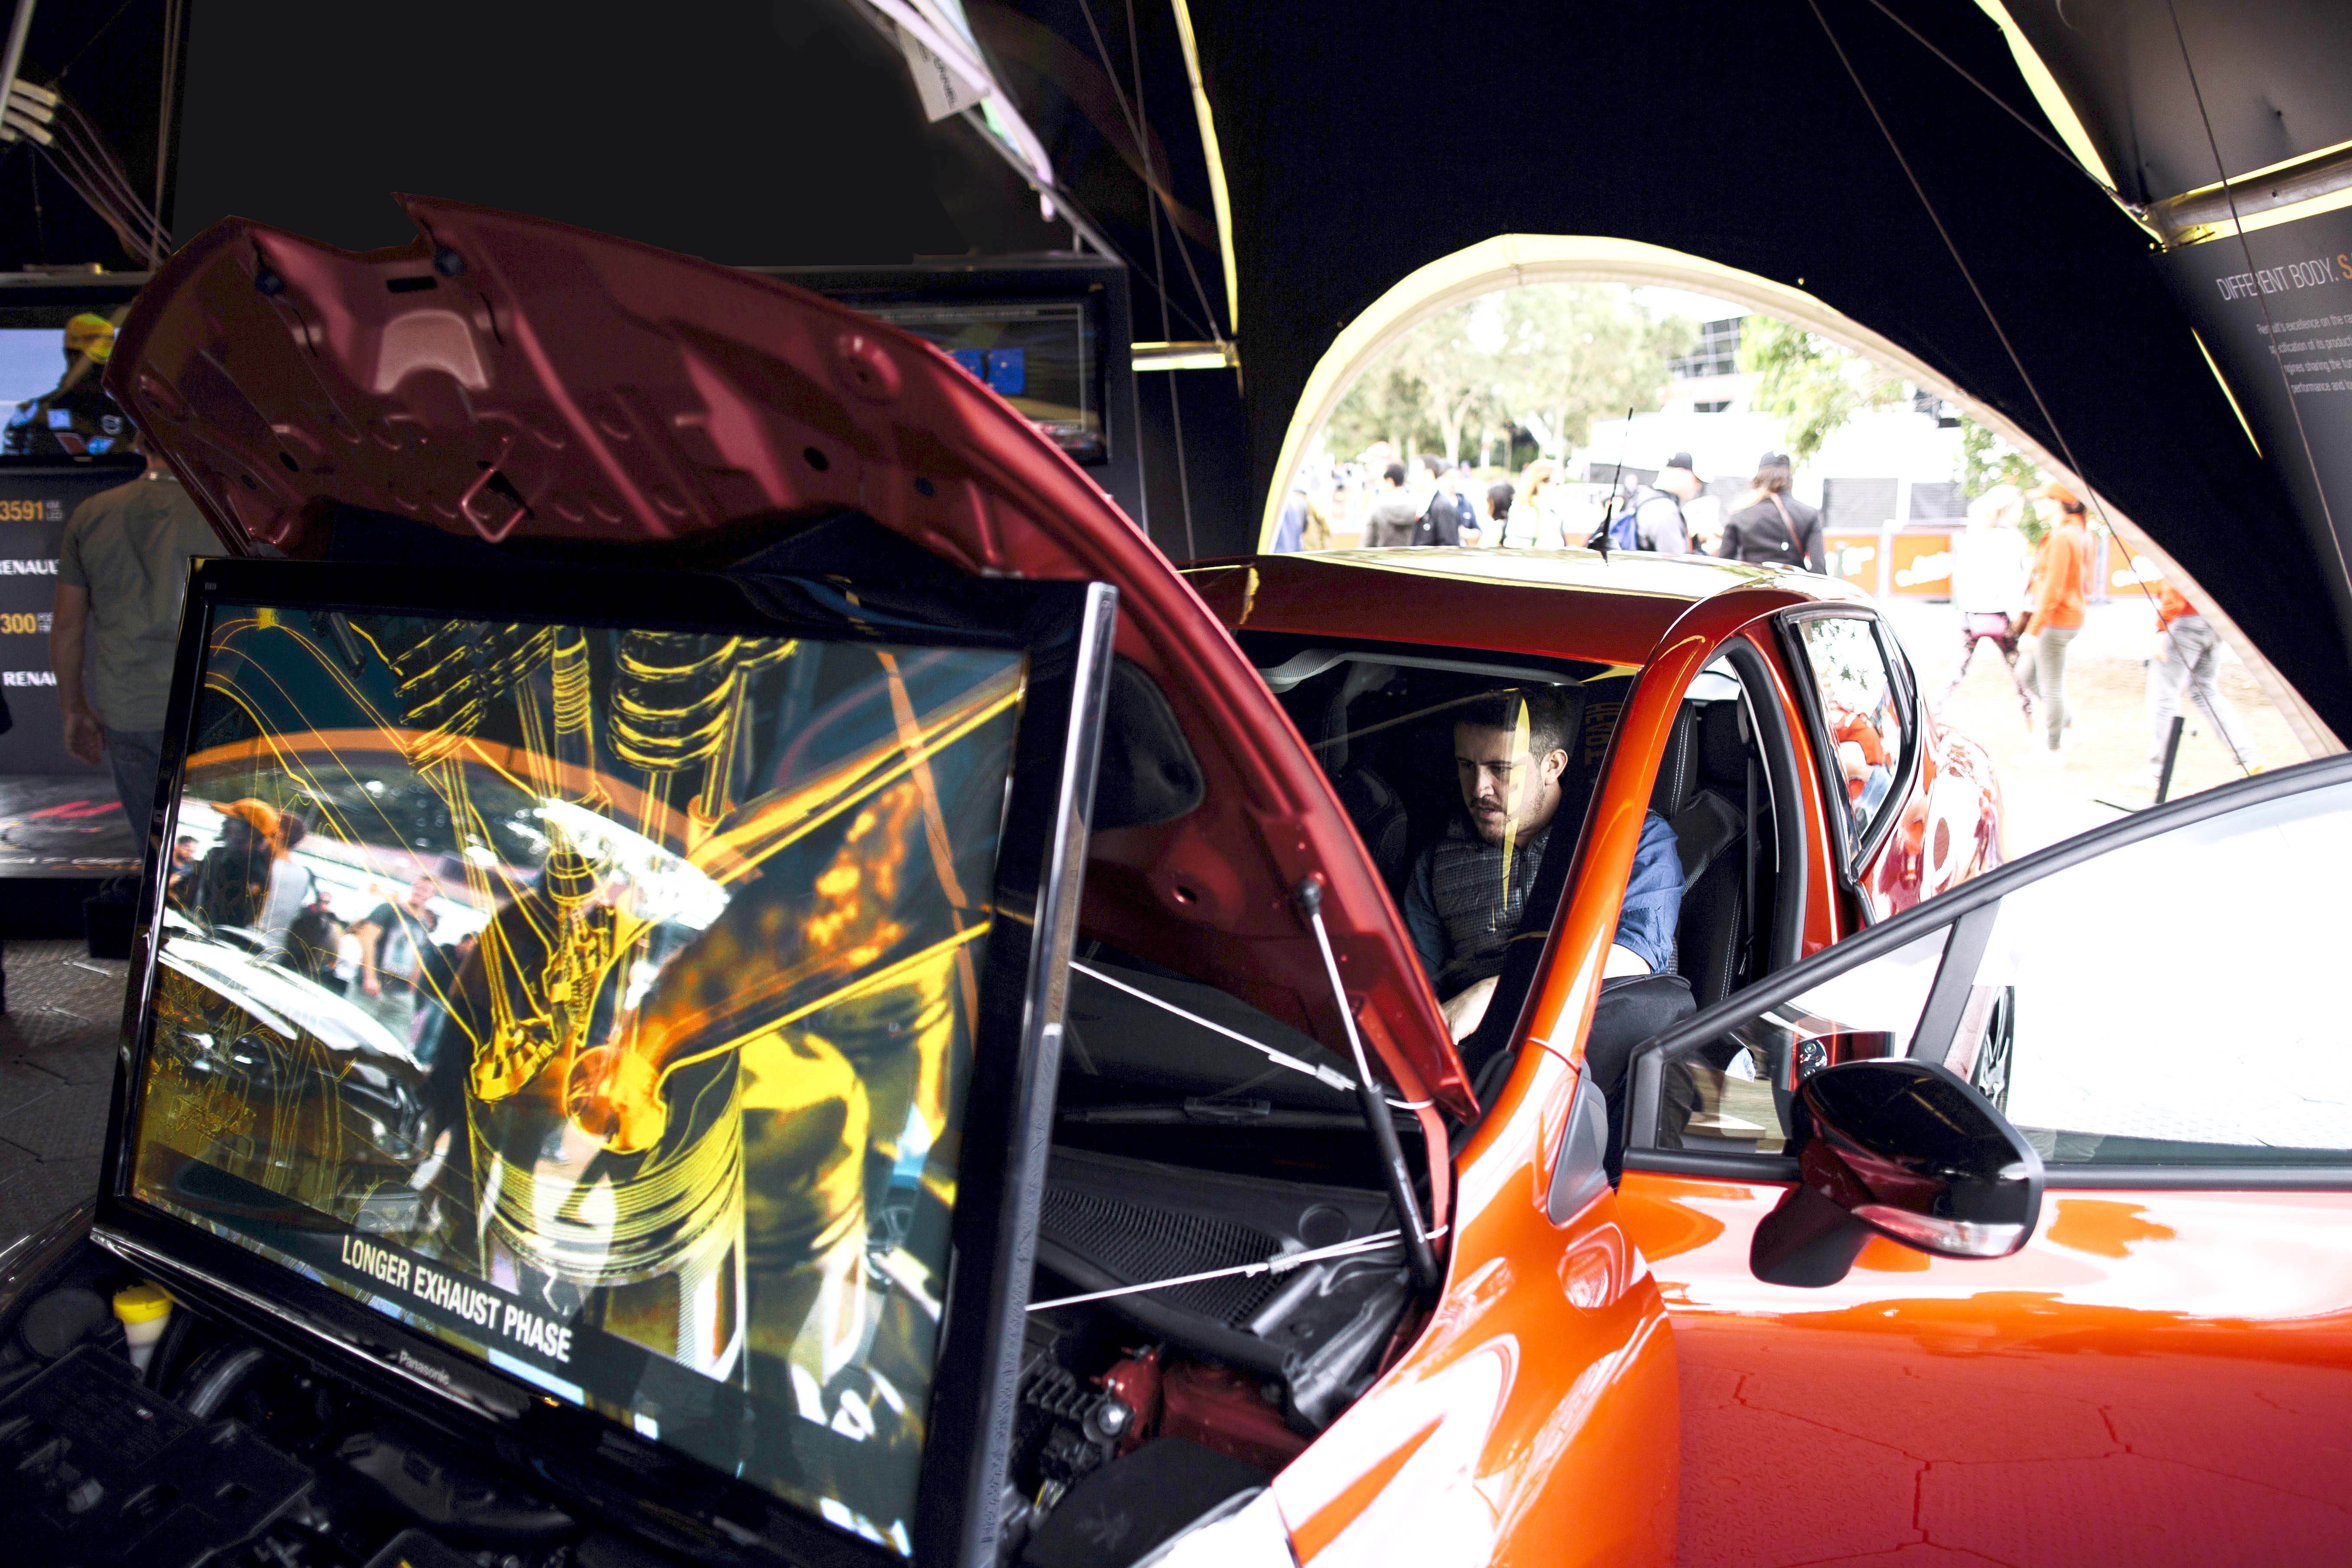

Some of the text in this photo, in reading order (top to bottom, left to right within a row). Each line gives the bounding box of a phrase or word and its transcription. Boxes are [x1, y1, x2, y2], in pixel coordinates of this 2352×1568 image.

[2216, 266, 2289, 301] DIFFERENT
[2288, 257, 2339, 288] BODY.
[2320, 318, 2331, 327] on
[2329, 314, 2343, 325] the
[0, 500, 43, 521] 3591
[0, 612, 37, 634] 300
[341, 1234, 572, 1364] LONGER EXHAUST PHASE
[398, 1349, 449, 1385] Panasonic
